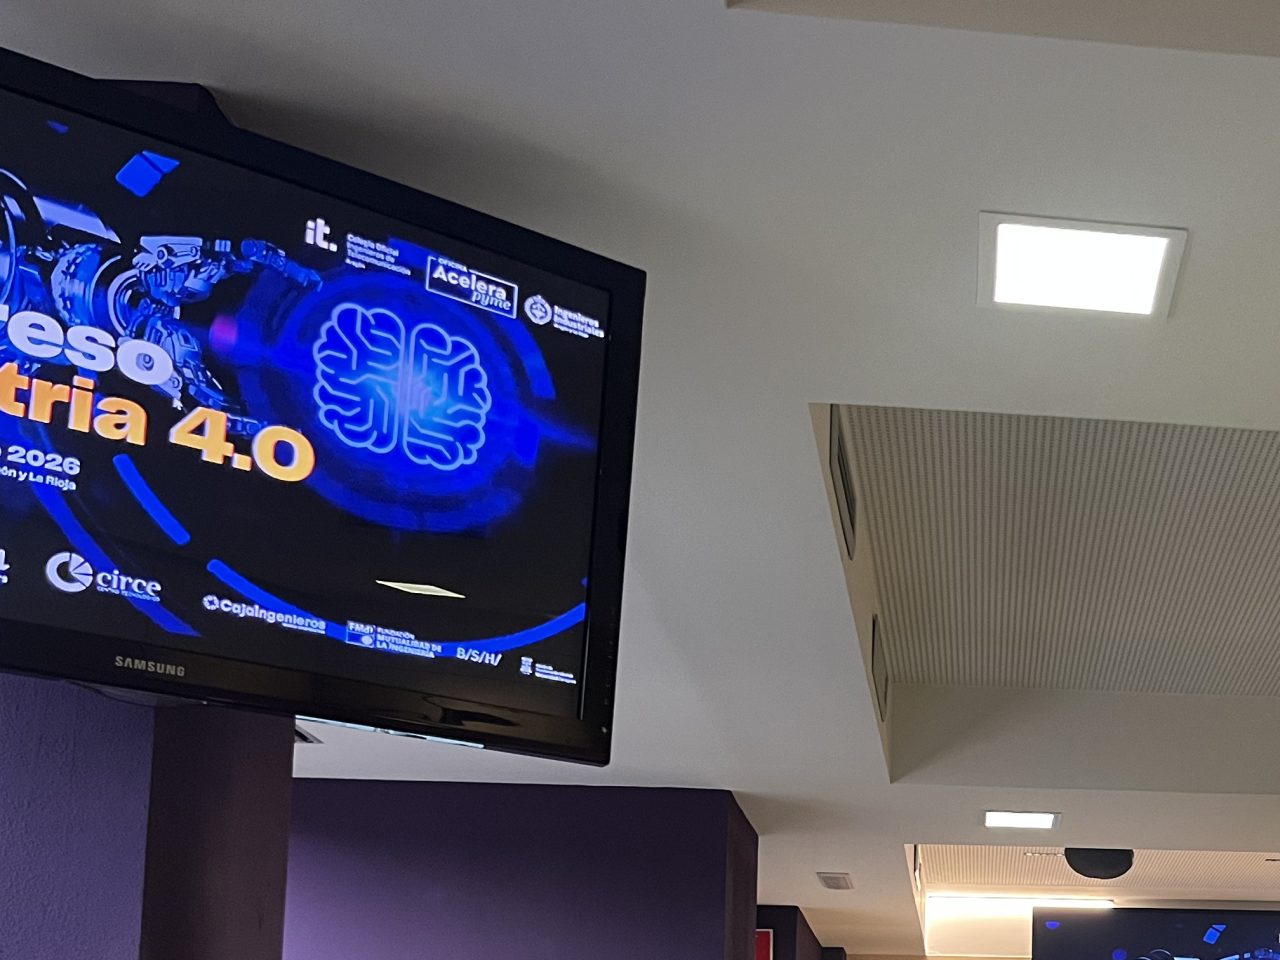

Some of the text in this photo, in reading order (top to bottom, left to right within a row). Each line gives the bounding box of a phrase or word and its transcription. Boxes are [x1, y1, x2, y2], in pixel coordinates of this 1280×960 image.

[305, 218, 338, 252] it.
[432, 265, 507, 300] Acelera
[471, 291, 512, 311] pyme
[0, 304, 174, 386] eso
[169, 406, 316, 483] 4.0
[7, 445, 81, 476] 2026
[28, 471, 44, 484] La
[45, 474, 77, 491] Rioja
[96, 569, 162, 597] circe
[114, 655, 186, 677] SAMSUNG
[455, 646, 502, 666] B/S/H/
